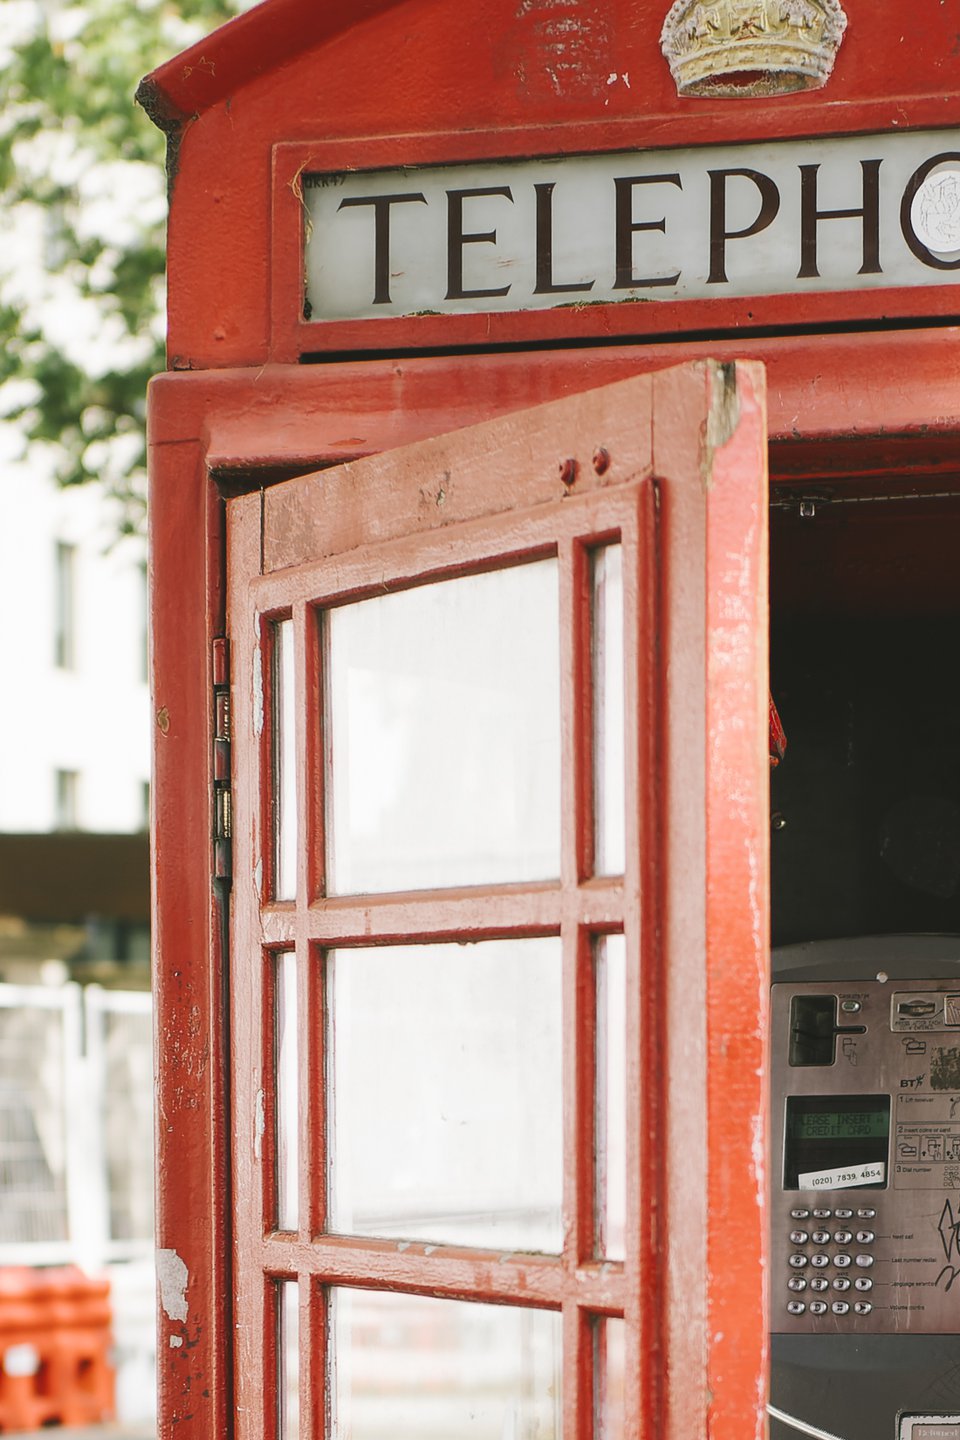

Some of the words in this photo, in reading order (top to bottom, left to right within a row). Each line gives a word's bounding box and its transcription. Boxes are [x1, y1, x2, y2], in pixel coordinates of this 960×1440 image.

[900, 1079, 916, 1088] BT
[807, 1126, 840, 1136] CREDIT
[812, 1177, 833, 1187] (020)
[837, 1173, 857, 1182] 7839
[860, 1169, 881, 1178] 4854
